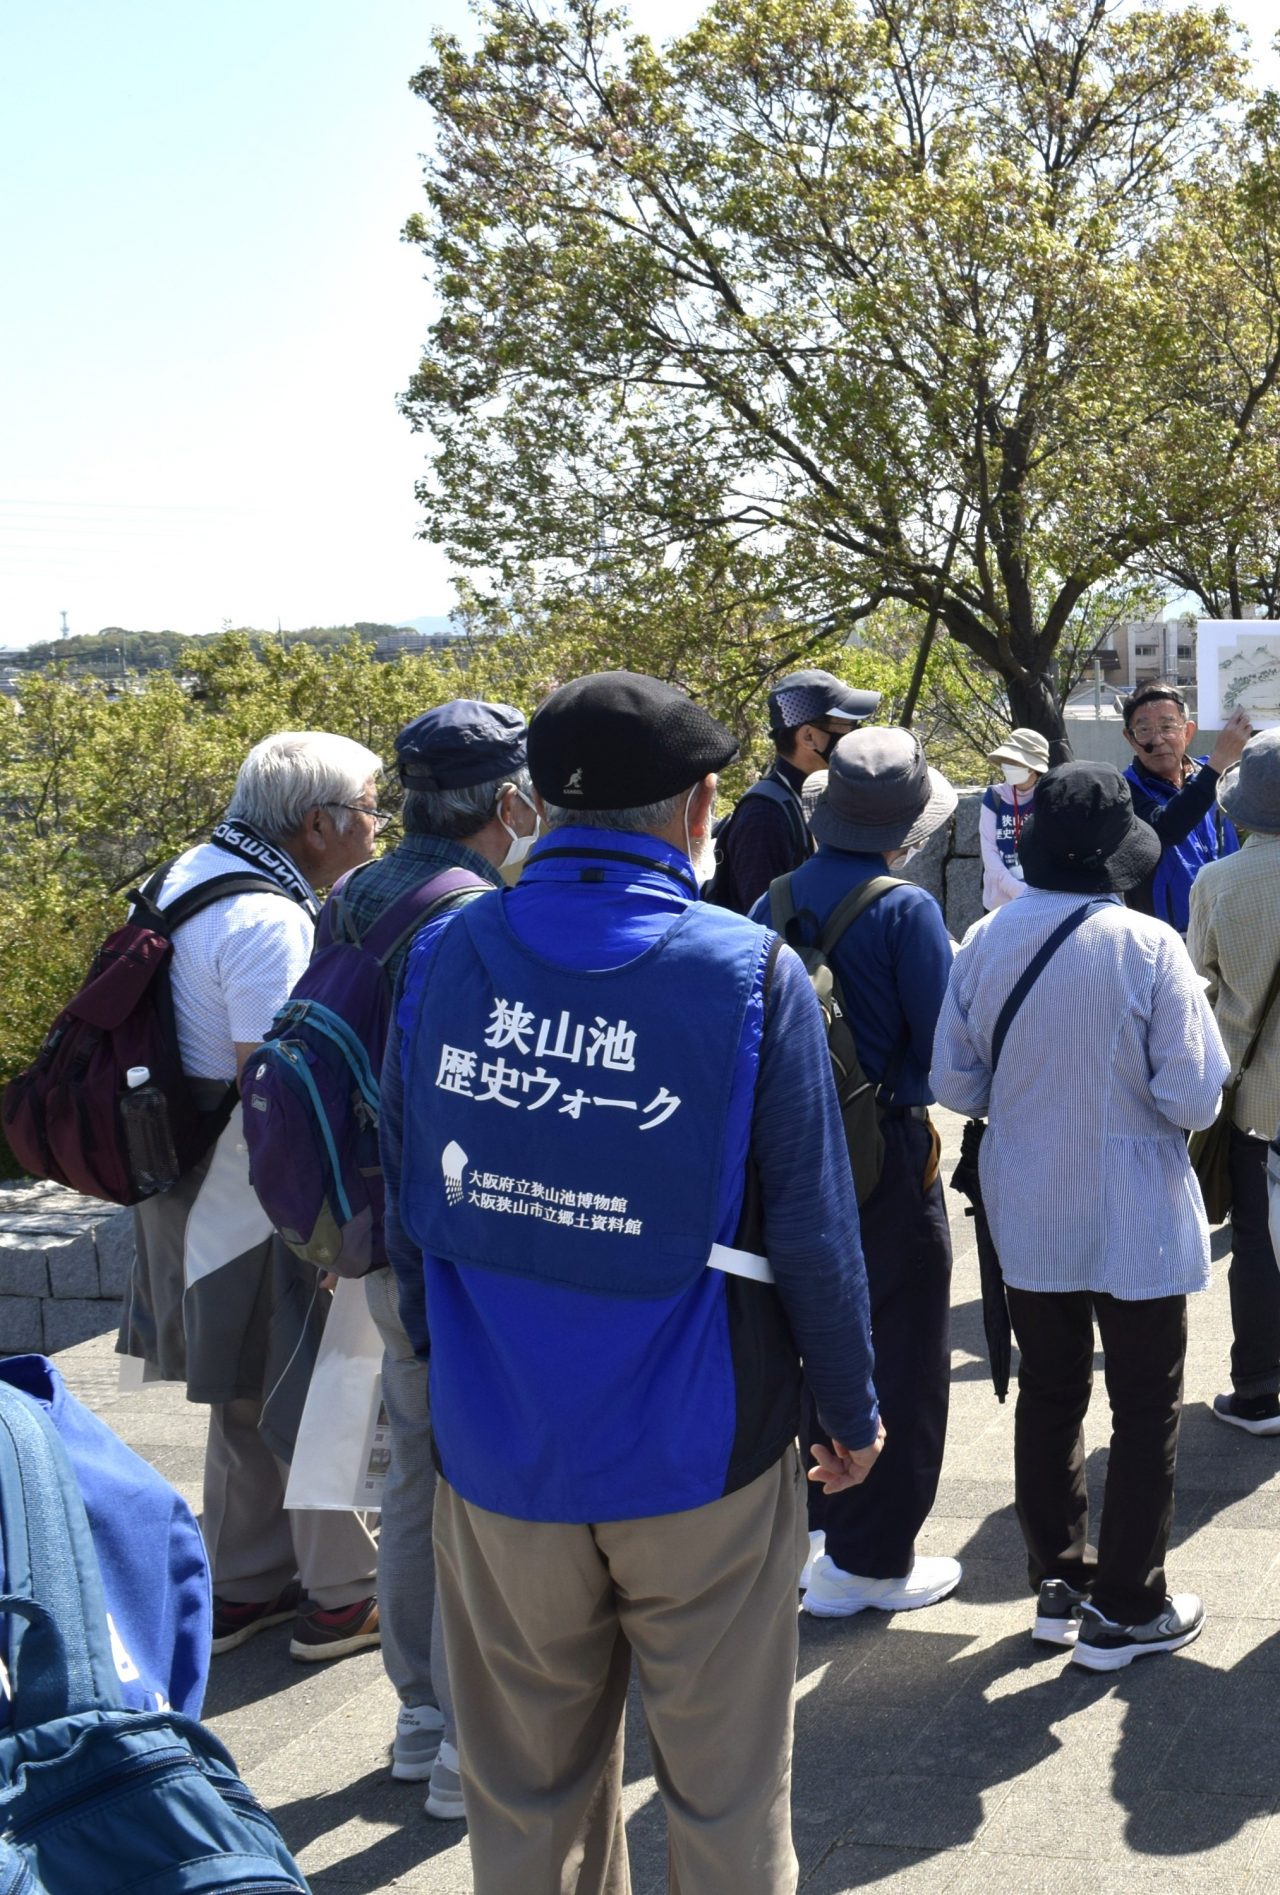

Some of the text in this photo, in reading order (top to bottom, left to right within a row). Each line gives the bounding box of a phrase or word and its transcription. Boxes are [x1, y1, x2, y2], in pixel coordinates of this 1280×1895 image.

[484, 997, 638, 1072] 狭山池
[435, 1044, 682, 1131] 歴史ウォーク
[468, 1169, 628, 1213] 大阪府立狭山池博物館
[468, 1190, 643, 1235] 大阪狭山市立郷土資料館
